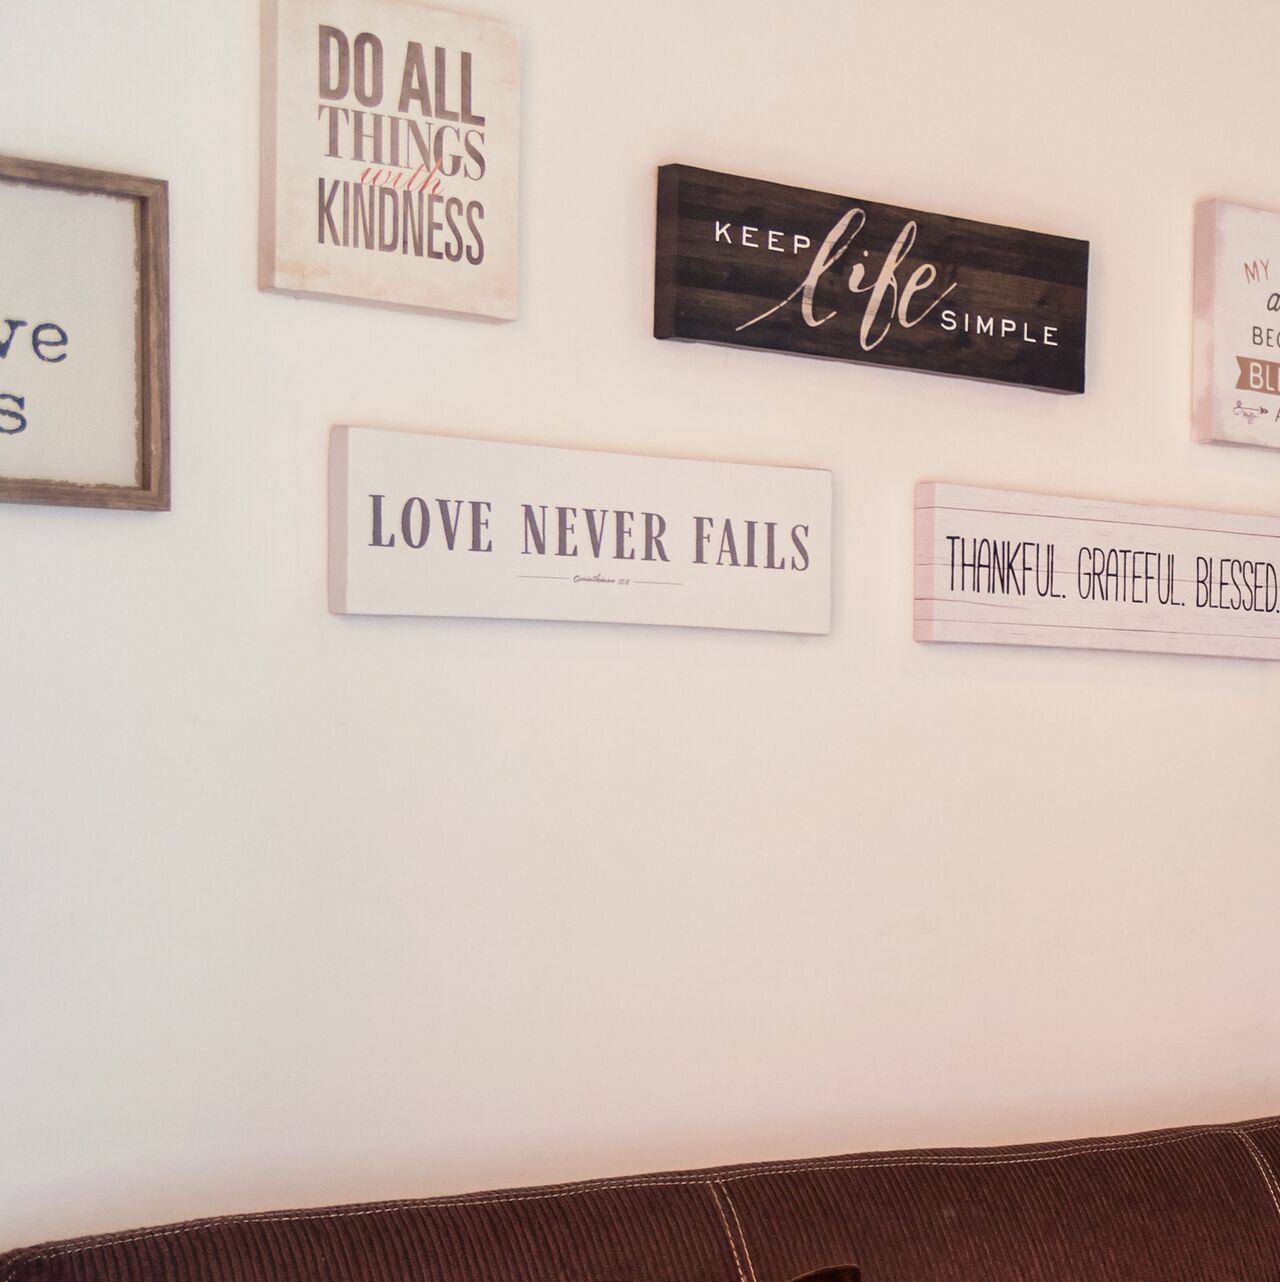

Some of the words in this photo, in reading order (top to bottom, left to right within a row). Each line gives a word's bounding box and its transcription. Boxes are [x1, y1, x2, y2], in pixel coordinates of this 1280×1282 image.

[318, 23, 384, 108] DO
[398, 40, 486, 127] ALL
[318, 104, 486, 181] THINGS
[360, 158, 447, 195] with
[318, 177, 485, 266] KINDNESS
[714, 220, 811, 255] KEEP
[735, 208, 958, 351] life
[1244, 258, 1270, 284] MY
[940, 310, 1059, 347] SIMPLE
[368, 494, 494, 552] LOVE
[520, 503, 671, 563] NEVER
[692, 515, 811, 572] FAILS
[946, 536, 1067, 599] THANKFUL.
[1077, 547, 1186, 607] GRATEFUL.
[1195, 556, 1280, 614] BLESSED.
